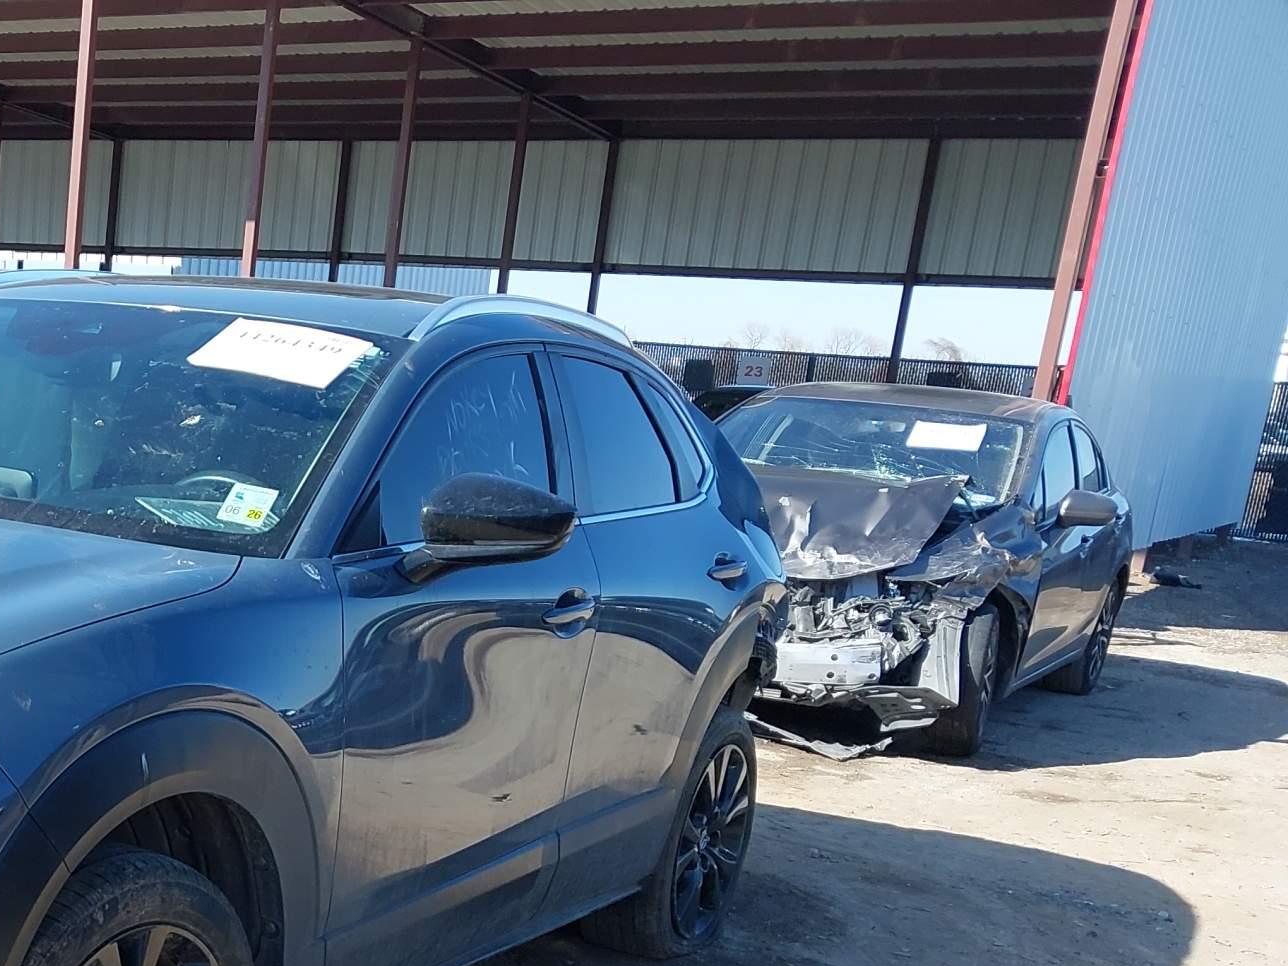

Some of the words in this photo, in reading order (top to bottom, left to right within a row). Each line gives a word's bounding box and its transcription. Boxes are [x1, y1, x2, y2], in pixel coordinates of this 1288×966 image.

[743, 365, 764, 378] 23
[224, 504, 241, 515] 06
[247, 509, 263, 520] 26
